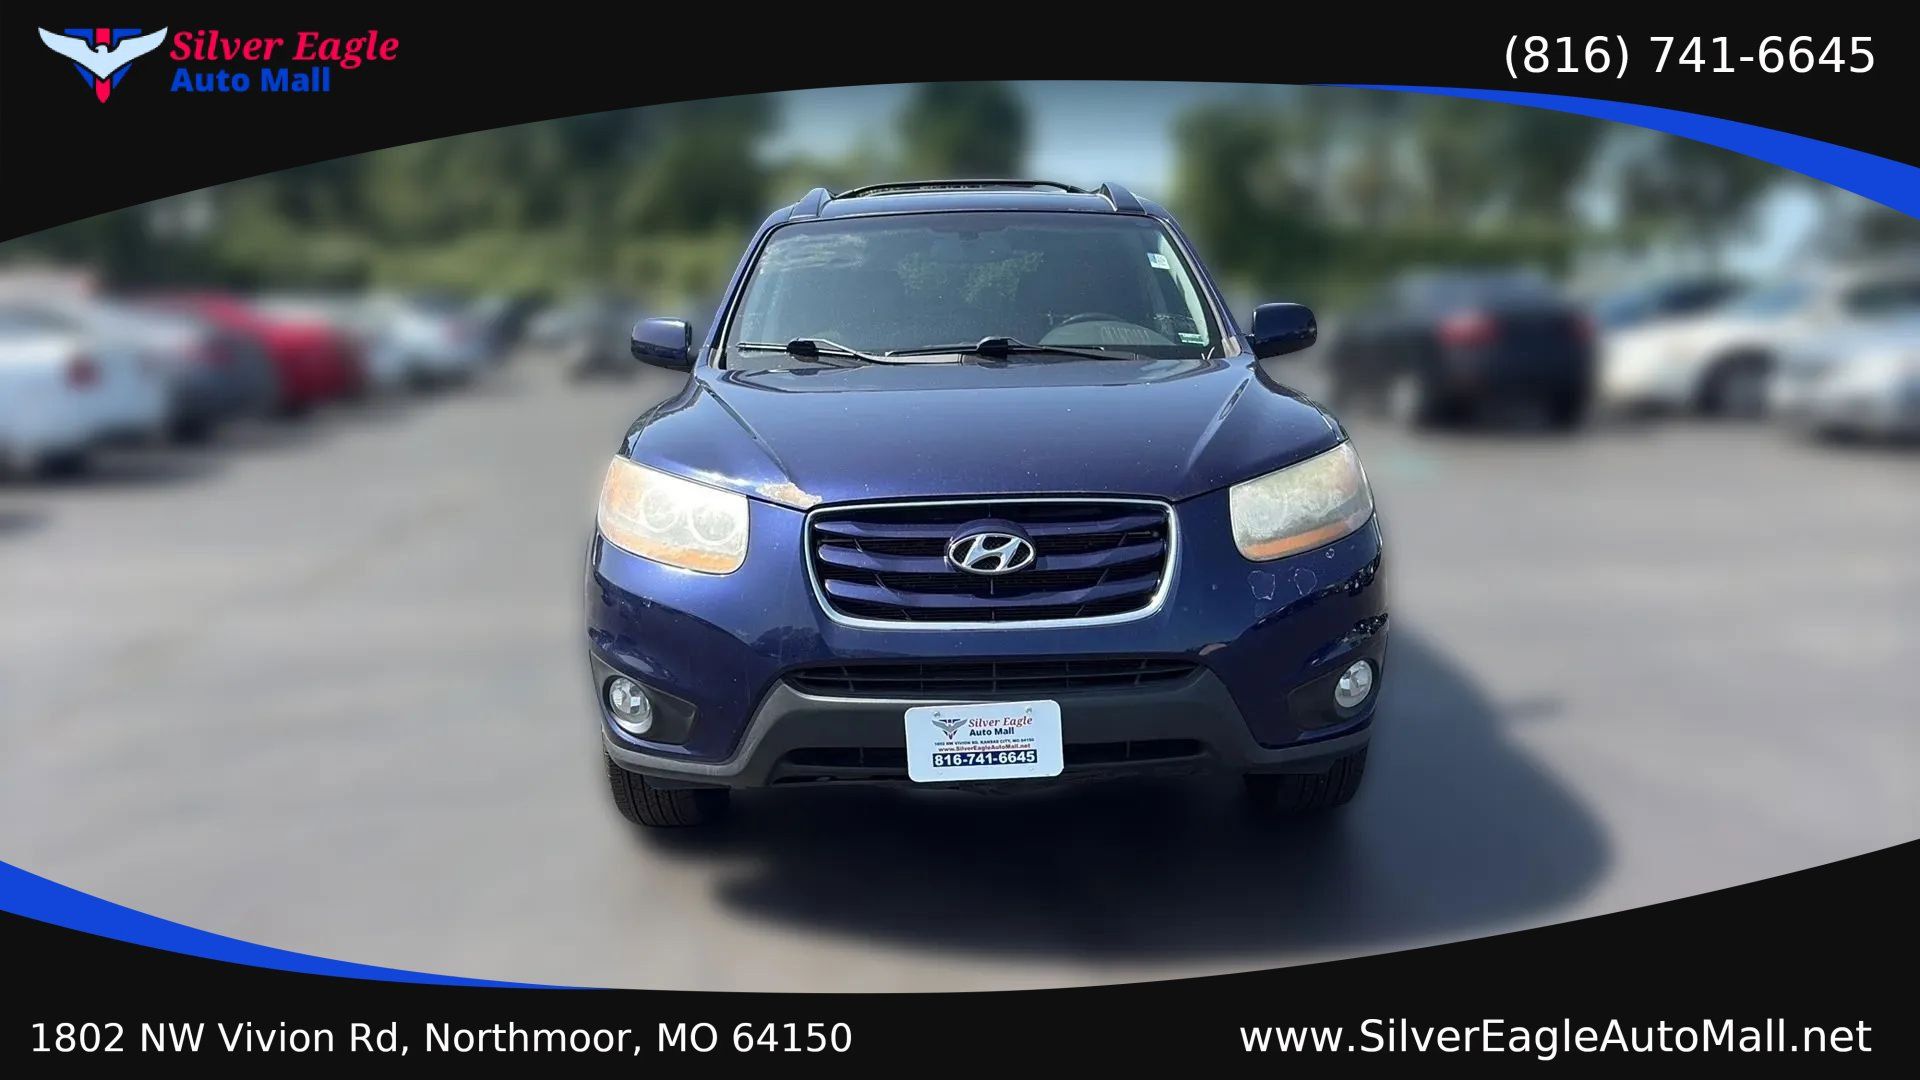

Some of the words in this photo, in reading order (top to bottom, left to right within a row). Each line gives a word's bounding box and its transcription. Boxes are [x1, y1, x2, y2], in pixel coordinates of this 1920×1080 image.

[968, 718, 1000, 728] Silver
[1003, 716, 1033, 727] Eagle
[969, 729, 992, 737] Auto
[994, 727, 1015, 736] Mall
[938, 743, 1031, 752] www.SilverEagleAutoMall.net
[934, 752, 1035, 766] 816-741-6645
